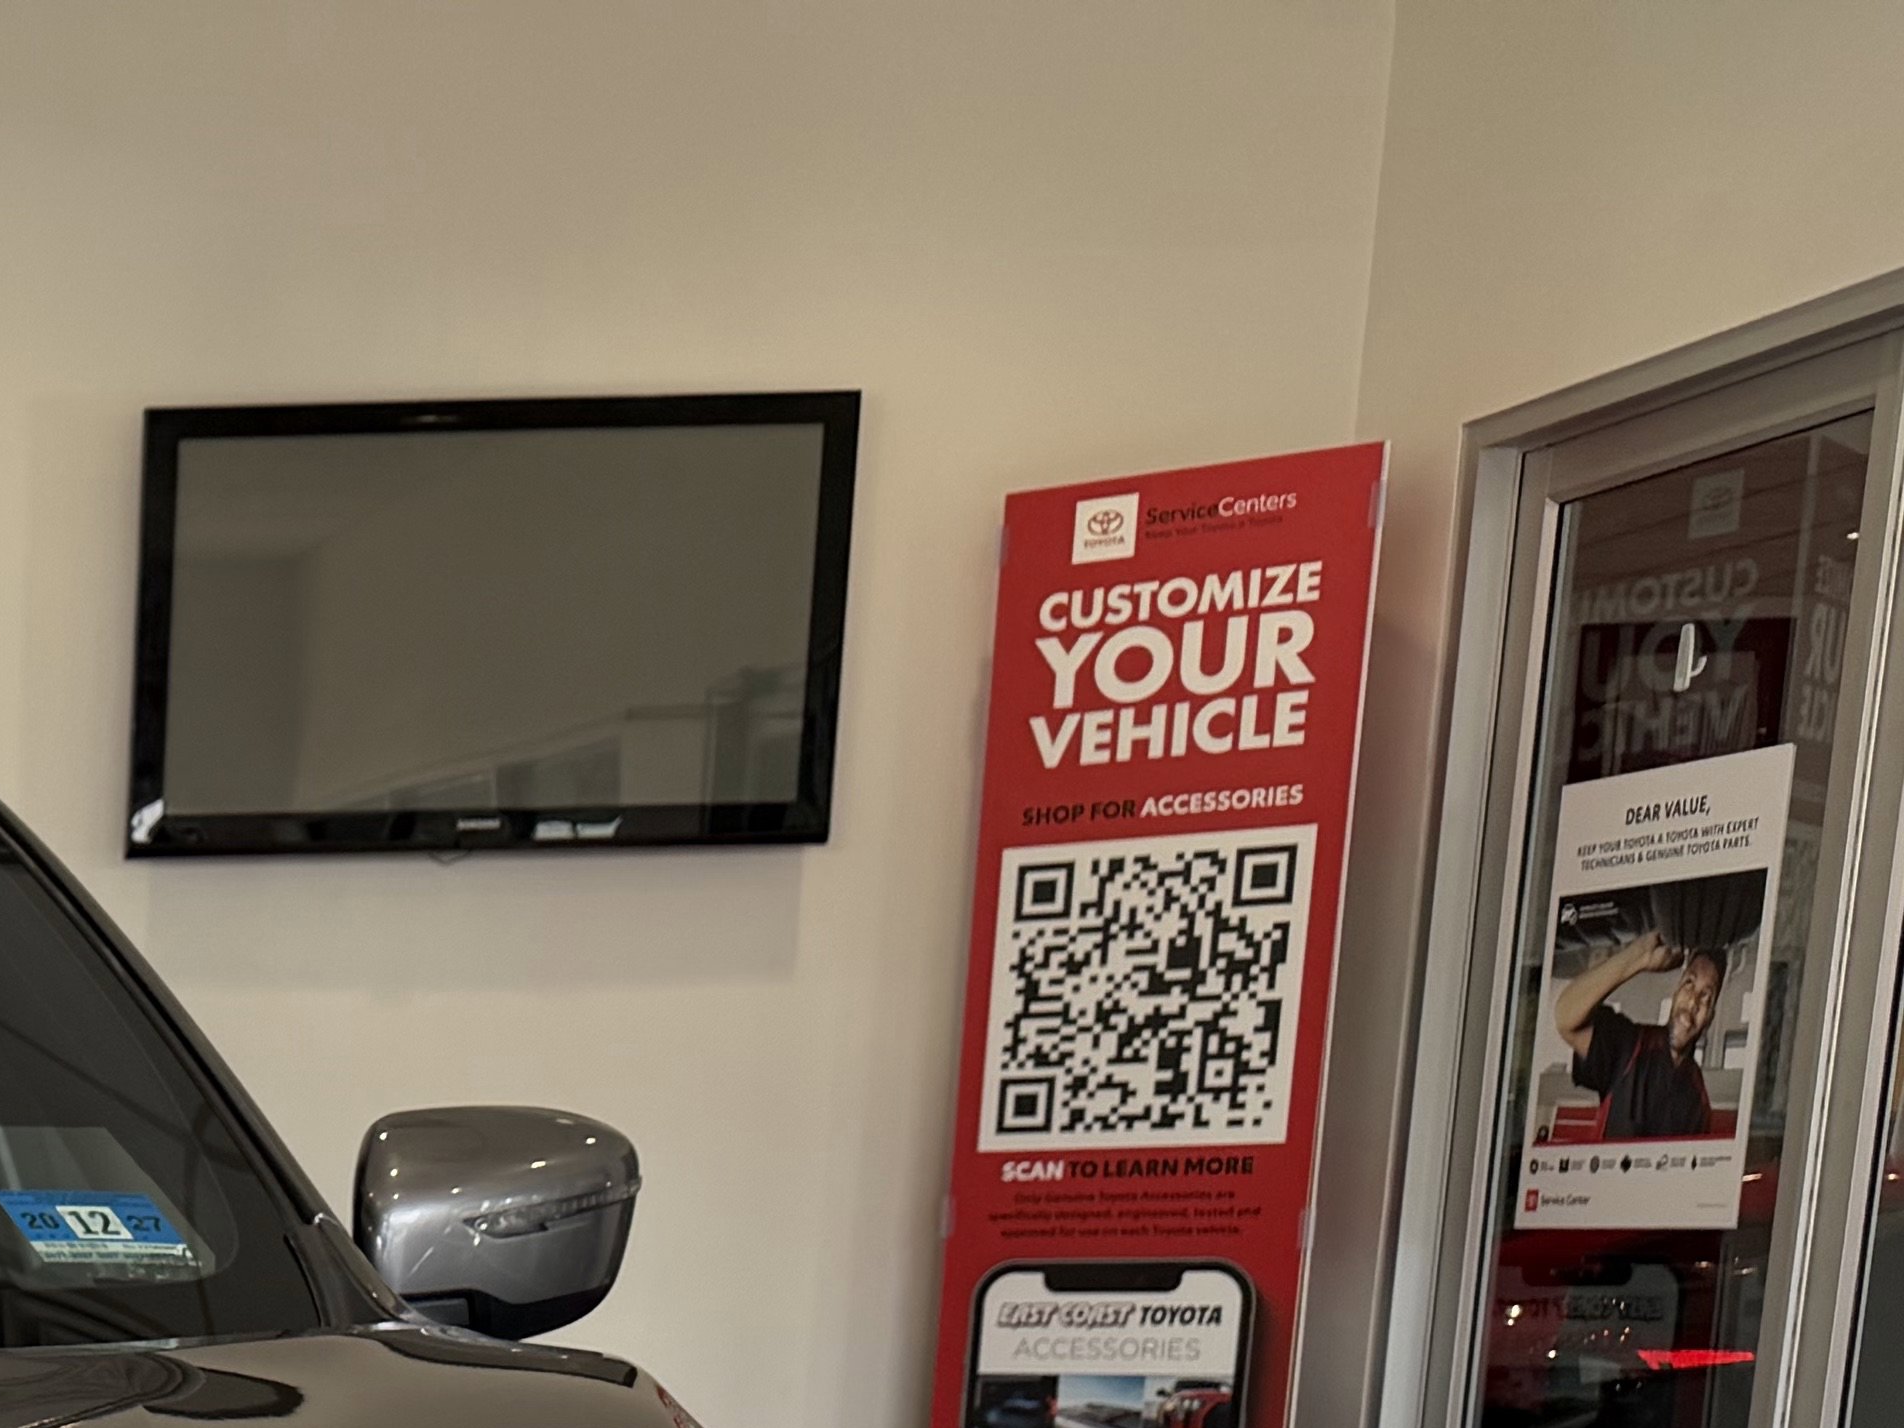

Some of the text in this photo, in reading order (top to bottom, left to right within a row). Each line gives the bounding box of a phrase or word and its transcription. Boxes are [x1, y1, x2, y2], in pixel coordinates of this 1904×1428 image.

[1039, 560, 1322, 631] CUSTOMIZE
[1035, 609, 1316, 710] YOUR
[1028, 690, 1310, 770] VEHICLE
[1022, 783, 1304, 827] SHOP FOR ACCESSORIES
[1625, 795, 1711, 826] DEAR VALUE,
[1000, 1155, 1254, 1183] SCAN TO LEARN MORE
[20, 1209, 163, 1236] 20 12 27
[996, 1302, 1223, 1329] EAST COAST TOYOTA
[1013, 1335, 1202, 1362] ACCESSORIES
